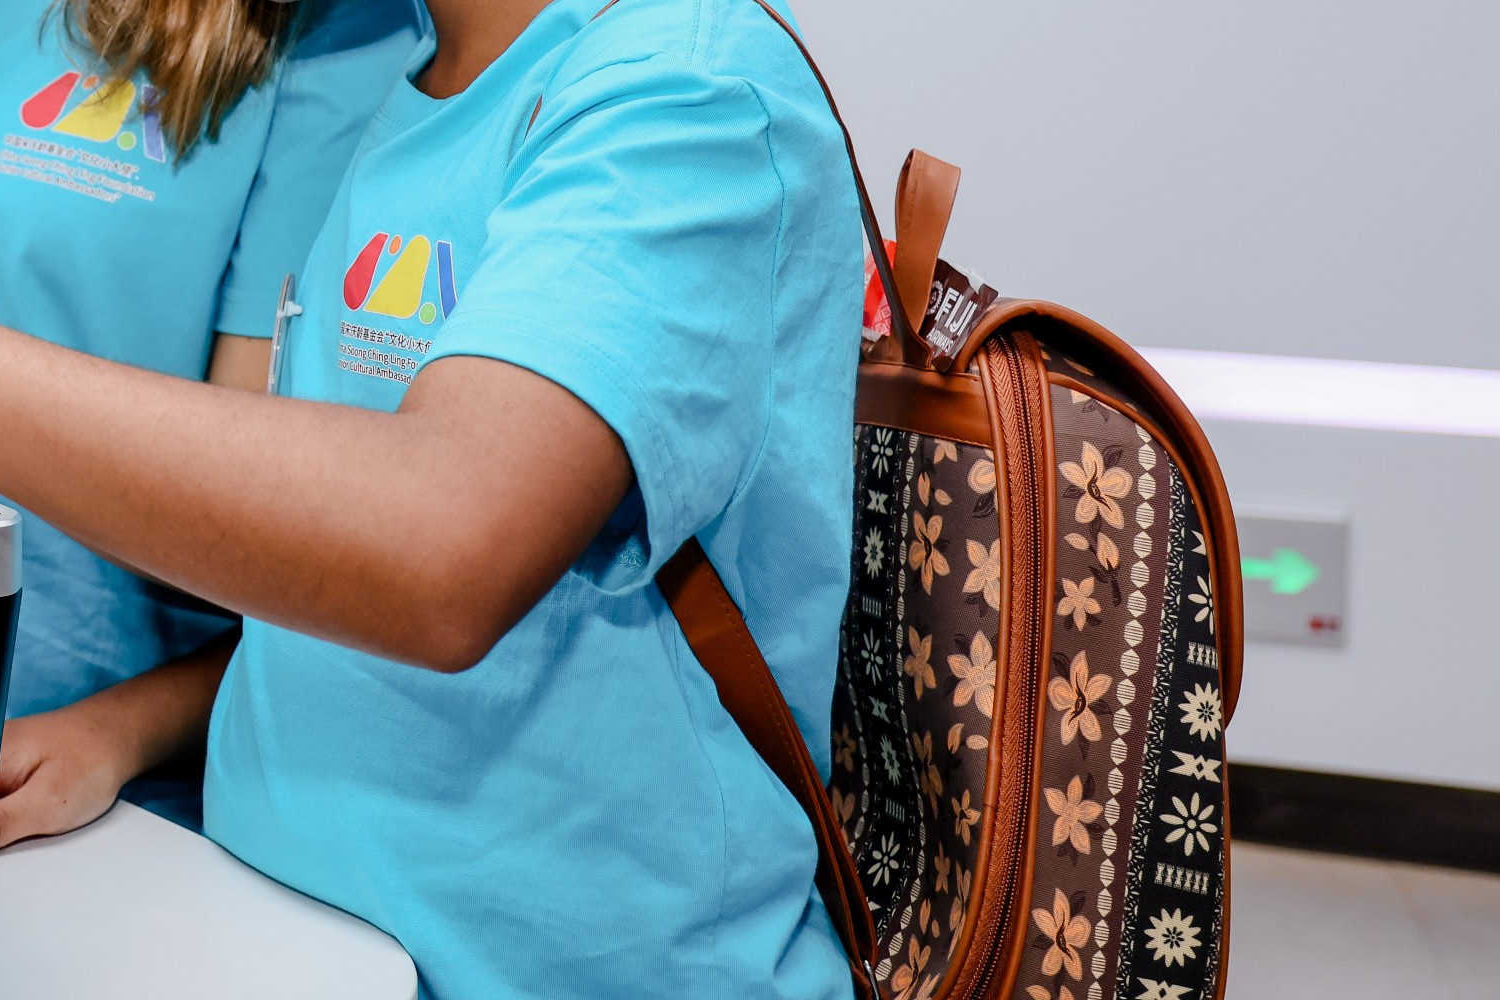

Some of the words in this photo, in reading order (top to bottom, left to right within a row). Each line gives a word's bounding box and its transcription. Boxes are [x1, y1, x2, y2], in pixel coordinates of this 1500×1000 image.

[98, 174, 155, 201] Foundation
[934, 287, 978, 336] FIJI
[926, 327, 954, 352] AIRWAYS
[348, 345, 367, 361] Soong
[368, 349, 389, 366] Ching
[390, 353, 406, 370] Ling
[350, 361, 375, 376] Cultural
[377, 367, 412, 385] Ambassad
